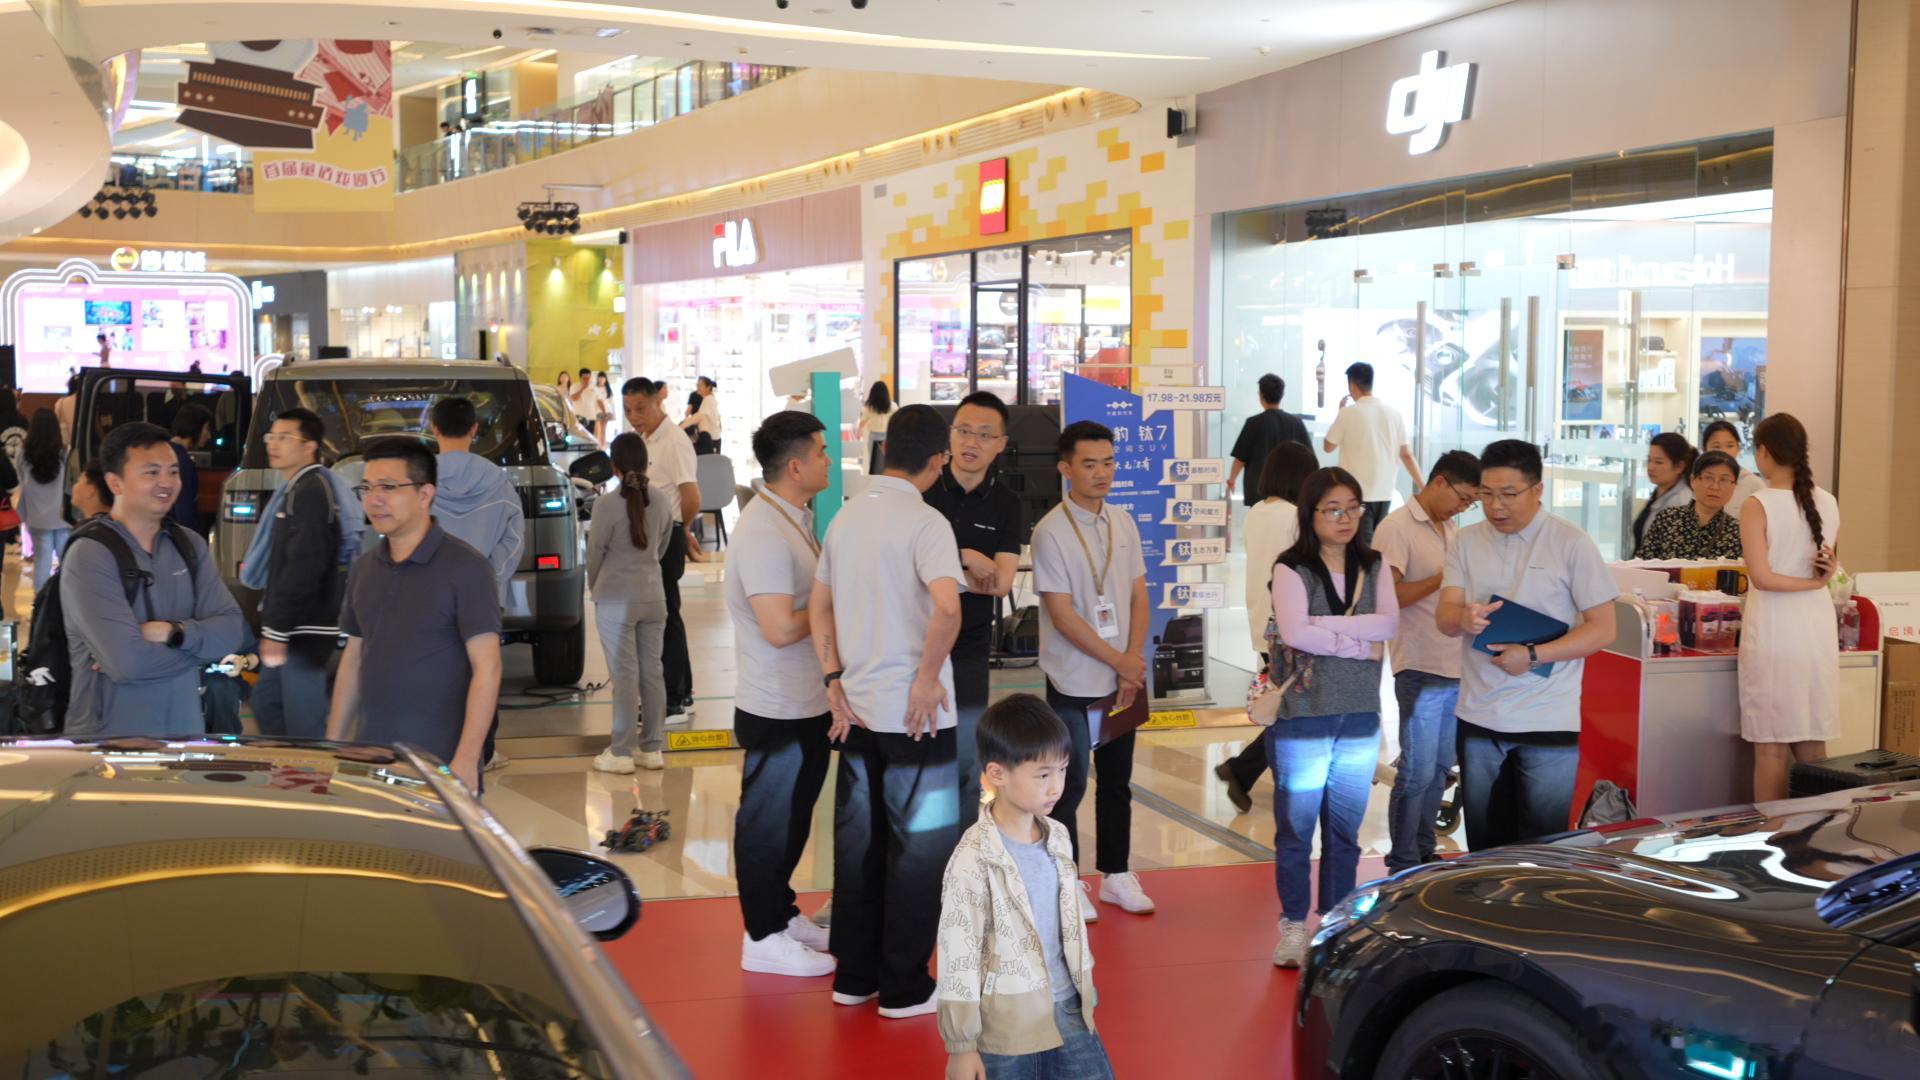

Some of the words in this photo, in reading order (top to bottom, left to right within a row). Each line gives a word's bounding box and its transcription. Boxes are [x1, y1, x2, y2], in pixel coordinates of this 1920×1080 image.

[1138, 425, 1168, 442] 钛7
[1176, 463, 1191, 476] 钛
[1179, 503, 1192, 516] 钛
[1178, 543, 1192, 556] 钛
[1177, 587, 1190, 600] 钛
